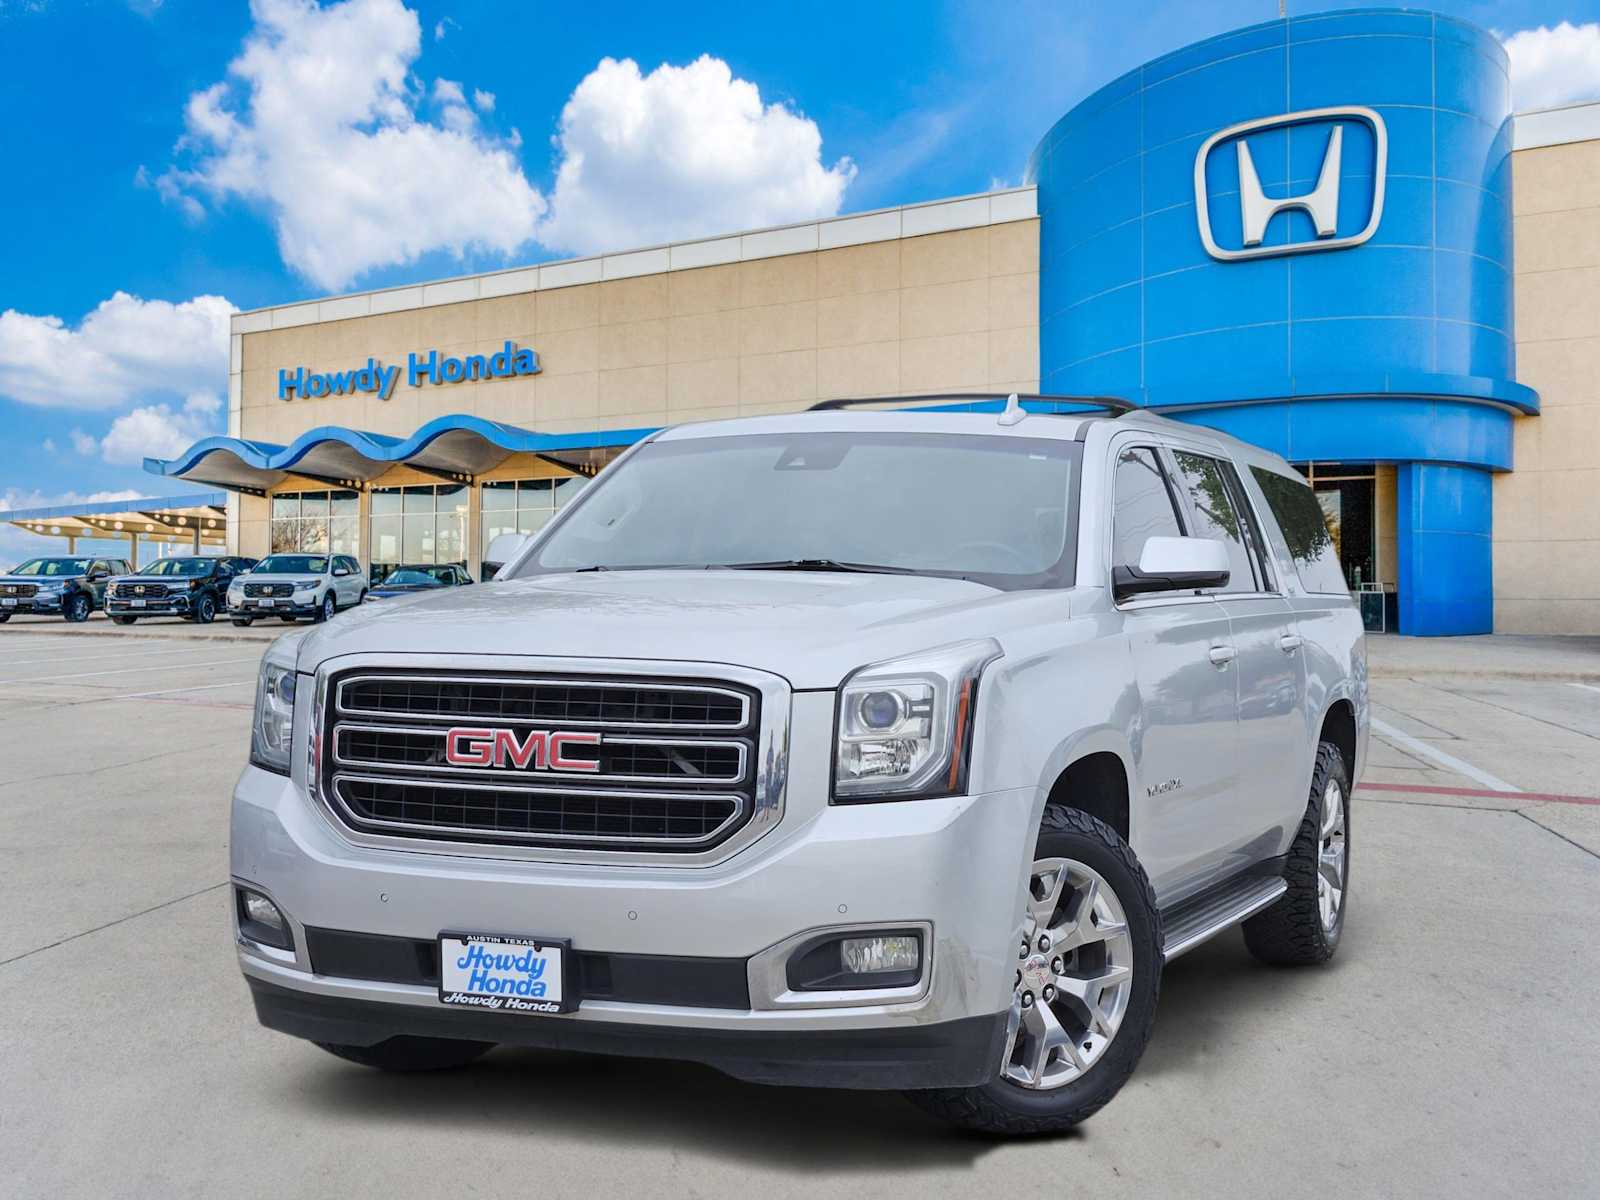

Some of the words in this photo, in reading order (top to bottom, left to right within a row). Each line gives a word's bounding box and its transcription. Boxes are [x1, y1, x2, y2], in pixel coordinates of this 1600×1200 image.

[278, 358, 399, 400] Howdy
[408, 340, 541, 387] Honda
[446, 727, 601, 772] GMC
[466, 935, 500, 943] AUSTIN
[504, 938, 535, 946] TEXAS
[457, 945, 547, 978] Howdy
[467, 968, 547, 997] Honda
[443, 992, 502, 1008] Howdy
[505, 998, 560, 1013] Honda
